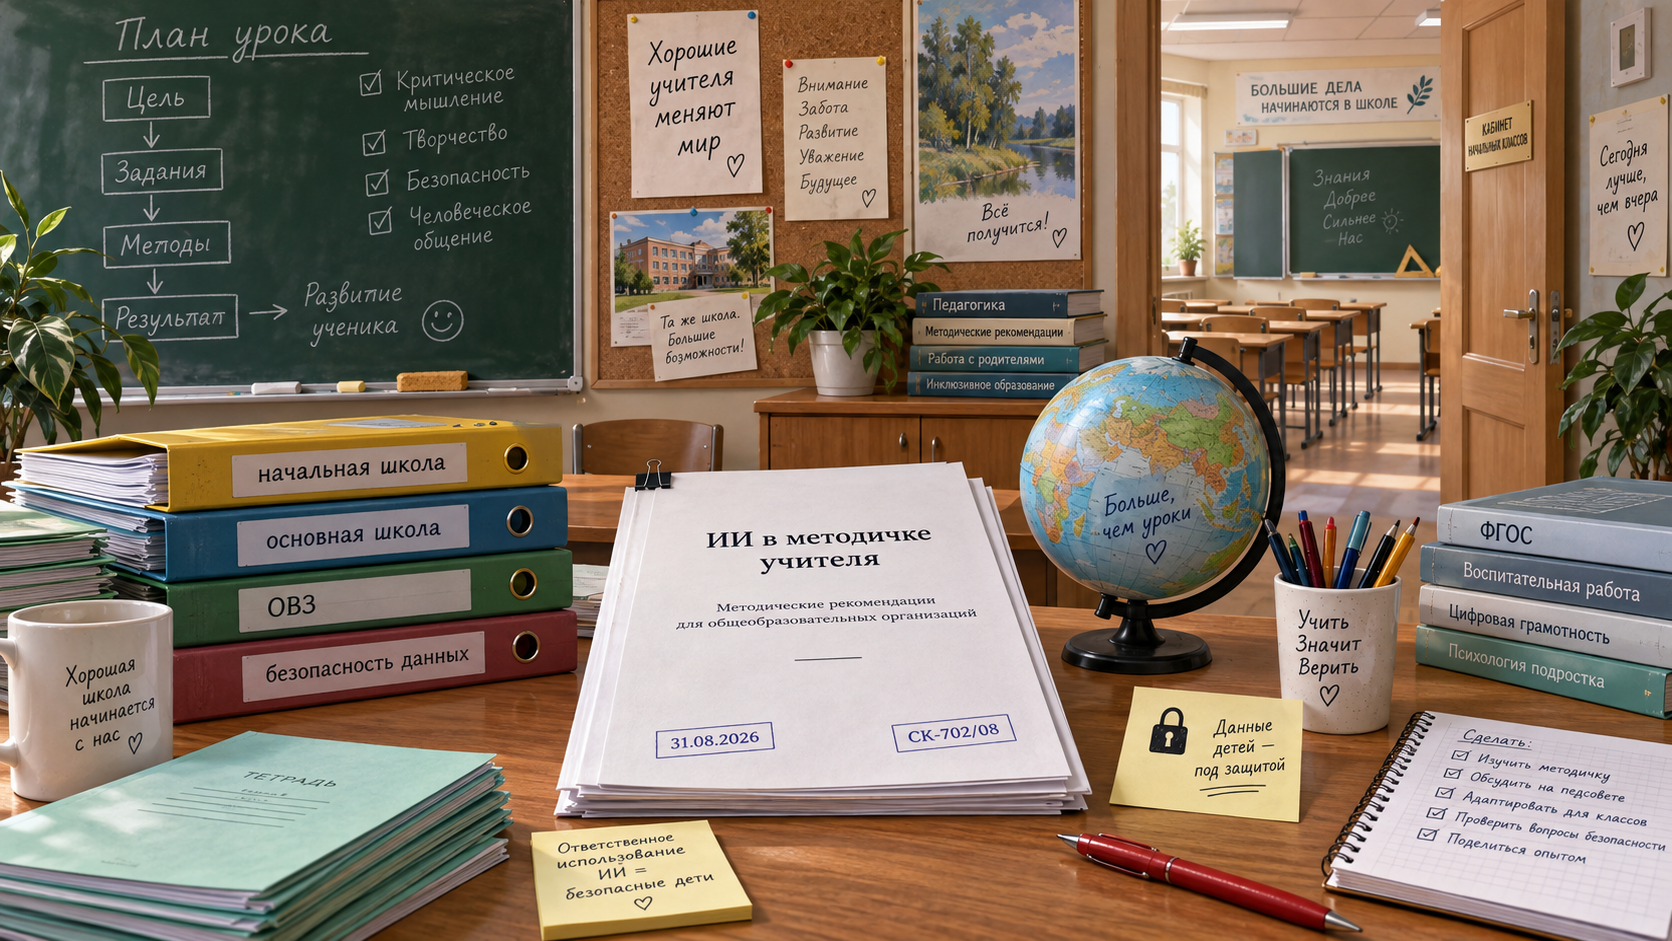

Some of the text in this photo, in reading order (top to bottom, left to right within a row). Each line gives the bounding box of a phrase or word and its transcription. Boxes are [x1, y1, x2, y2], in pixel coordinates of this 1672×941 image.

[116, 17, 333, 62] План урока
[648, 40, 737, 71] Хорошие
[398, 68, 514, 95] Критическое
[649, 71, 733, 107] учителя
[798, 76, 868, 92] Внимание
[1252, 81, 1362, 96] БОЛЬШИЕ ДЕЛА
[128, 86, 184, 114] Цель
[404, 91, 503, 111] мышление
[799, 100, 848, 116] Забота
[1262, 97, 1397, 113] НАЧИНАЮТСЯ В ШКОЛЕ
[655, 102, 735, 127] меняют
[403, 123, 507, 154] Творчество
[799, 124, 858, 140] Развитие
[678, 136, 720, 160] мир
[800, 149, 863, 165] Уважение
[1600, 140, 1647, 166] Сегодня
[115, 160, 206, 186] Задания
[408, 167, 530, 191] Безопасность
[801, 173, 857, 195] Будущее
[1313, 169, 1370, 187] Знания
[1606, 170, 1646, 195] лучше,
[1323, 189, 1375, 210] Добрее
[1598, 190, 1658, 215] чем вчера
[410, 202, 531, 225] Человеческое
[982, 203, 1008, 221] Всё
[1323, 214, 1375, 229] Сильнее
[967, 212, 1048, 245] получится!
[1338, 232, 1362, 246] Нас
[121, 234, 209, 257] Методы
[414, 230, 493, 251] общение
[305, 281, 402, 312] Развитие
[934, 298, 1005, 312] Педагогика
[116, 306, 225, 336] Результат
[661, 311, 740, 329] Та же школа.
[310, 320, 398, 347] ученика
[669, 331, 715, 346] Большие
[925, 326, 1063, 340] Методические рекомендации
[666, 338, 744, 364] возможности!
[928, 353, 1044, 367] Работа с родителями
[927, 379, 1054, 392] Инклюзивное образование
[259, 458, 445, 482] начальная школа
[1105, 490, 1174, 516] Больше,
[1103, 508, 1190, 539] чем уроки
[1481, 521, 1532, 544] ФГОС
[267, 523, 441, 549] основная школа
[707, 530, 931, 548] ИИ в методичке
[760, 555, 880, 574] учителя
[1464, 562, 1640, 601] Воспитательная работа
[268, 595, 315, 617] ОВЗ
[717, 598, 935, 612] Методические рекомендации
[676, 609, 976, 630] для общеобразовательных организаций
[1299, 609, 1349, 629] Учить
[1450, 604, 1610, 644] Цифровая грамотность
[1296, 635, 1362, 652] Значит
[66, 659, 135, 689] Хорошая
[266, 649, 469, 682] безопасность данных
[1299, 658, 1358, 681] Верить
[1449, 643, 1604, 688] Психология подростка
[83, 684, 131, 705] школа
[71, 697, 154, 730] начинается
[908, 724, 999, 742] СК-702/08
[1213, 719, 1272, 738] Данные
[1463, 729, 1532, 748] Сделать:
[76, 730, 120, 751] с нас
[671, 732, 759, 749] 31.08.2026
[1213, 739, 1254, 758] детей
[244, 772, 336, 787] ТЕТРАДЬ
[1195, 757, 1284, 781] под защитой
[1478, 754, 1610, 784] Изучить методичку
[1471, 772, 1531, 788] Обсудить
[1561, 788, 1625, 802] педсовете
[1463, 791, 1647, 826] Адаптировать для классов
[1455, 812, 1665, 851] Проверить вопросы безопасности
[558, 835, 675, 854] Ответственное
[1448, 833, 1586, 864] Поделиться опытом
[558, 845, 685, 870] использование
[566, 874, 714, 900] безопасные дети
